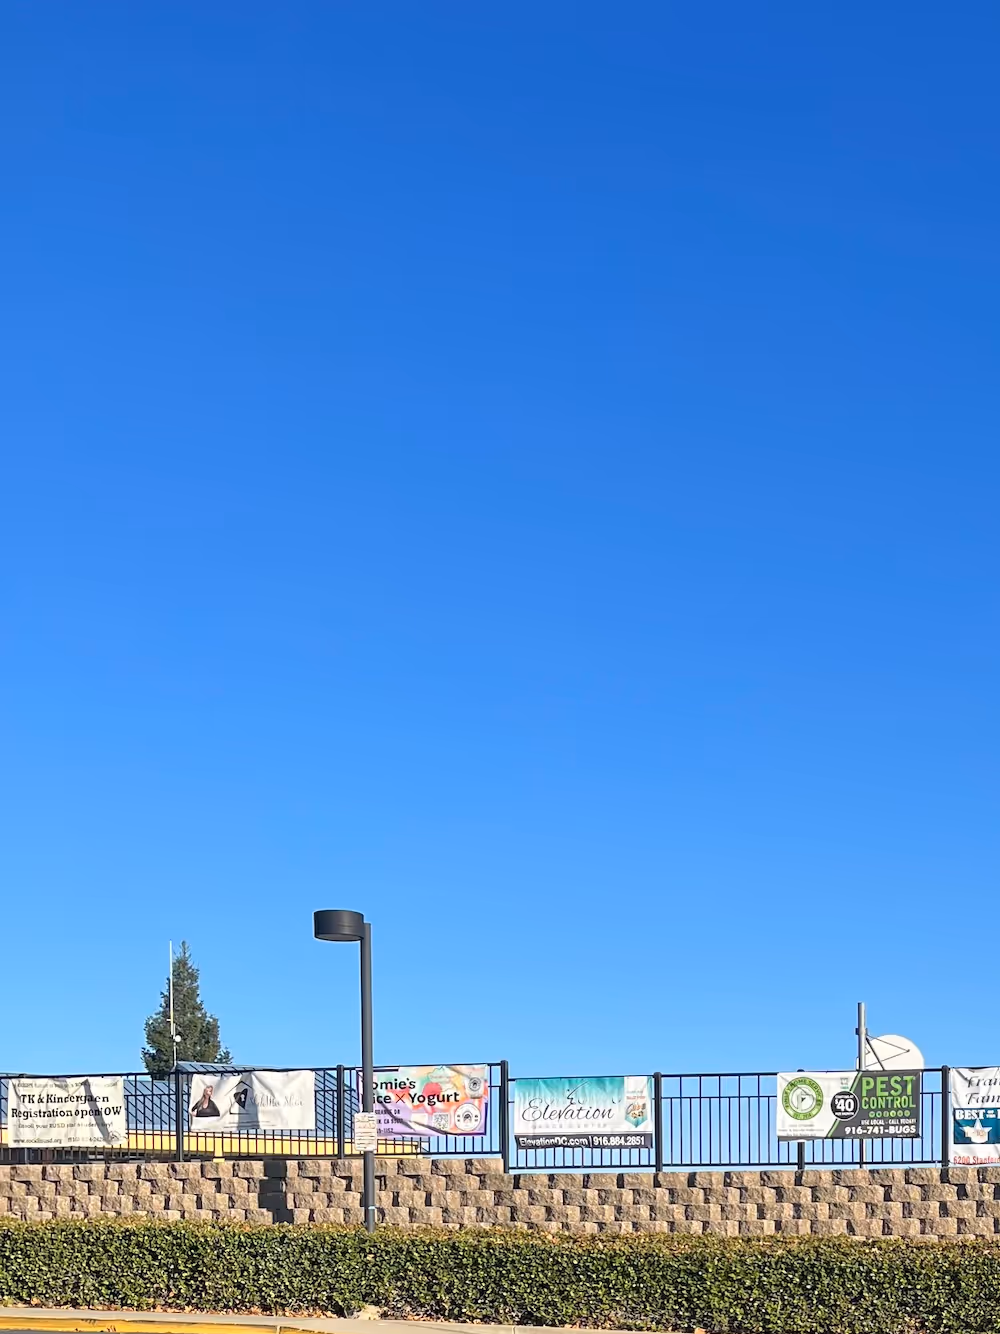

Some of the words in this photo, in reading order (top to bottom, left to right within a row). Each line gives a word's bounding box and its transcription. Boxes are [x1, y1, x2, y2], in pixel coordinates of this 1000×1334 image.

[373, 1078, 417, 1090] omie's
[861, 1076, 917, 1097] PEST
[21, 1094, 35, 1104] TK
[37, 1094, 45, 1104] &
[372, 1093, 392, 1104] ice
[409, 1092, 460, 1106] Yogurt
[835, 1098, 855, 1112] $40
[861, 1096, 916, 1109] CONTROL
[11, 1108, 73, 1120] Registration
[74, 1109, 100, 1119] open
[101, 1106, 122, 1116] OW
[522, 1098, 615, 1122] Elevation
[955, 1109, 985, 1120] BEST
[844, 1125, 916, 1135] 916-741-BUGS
